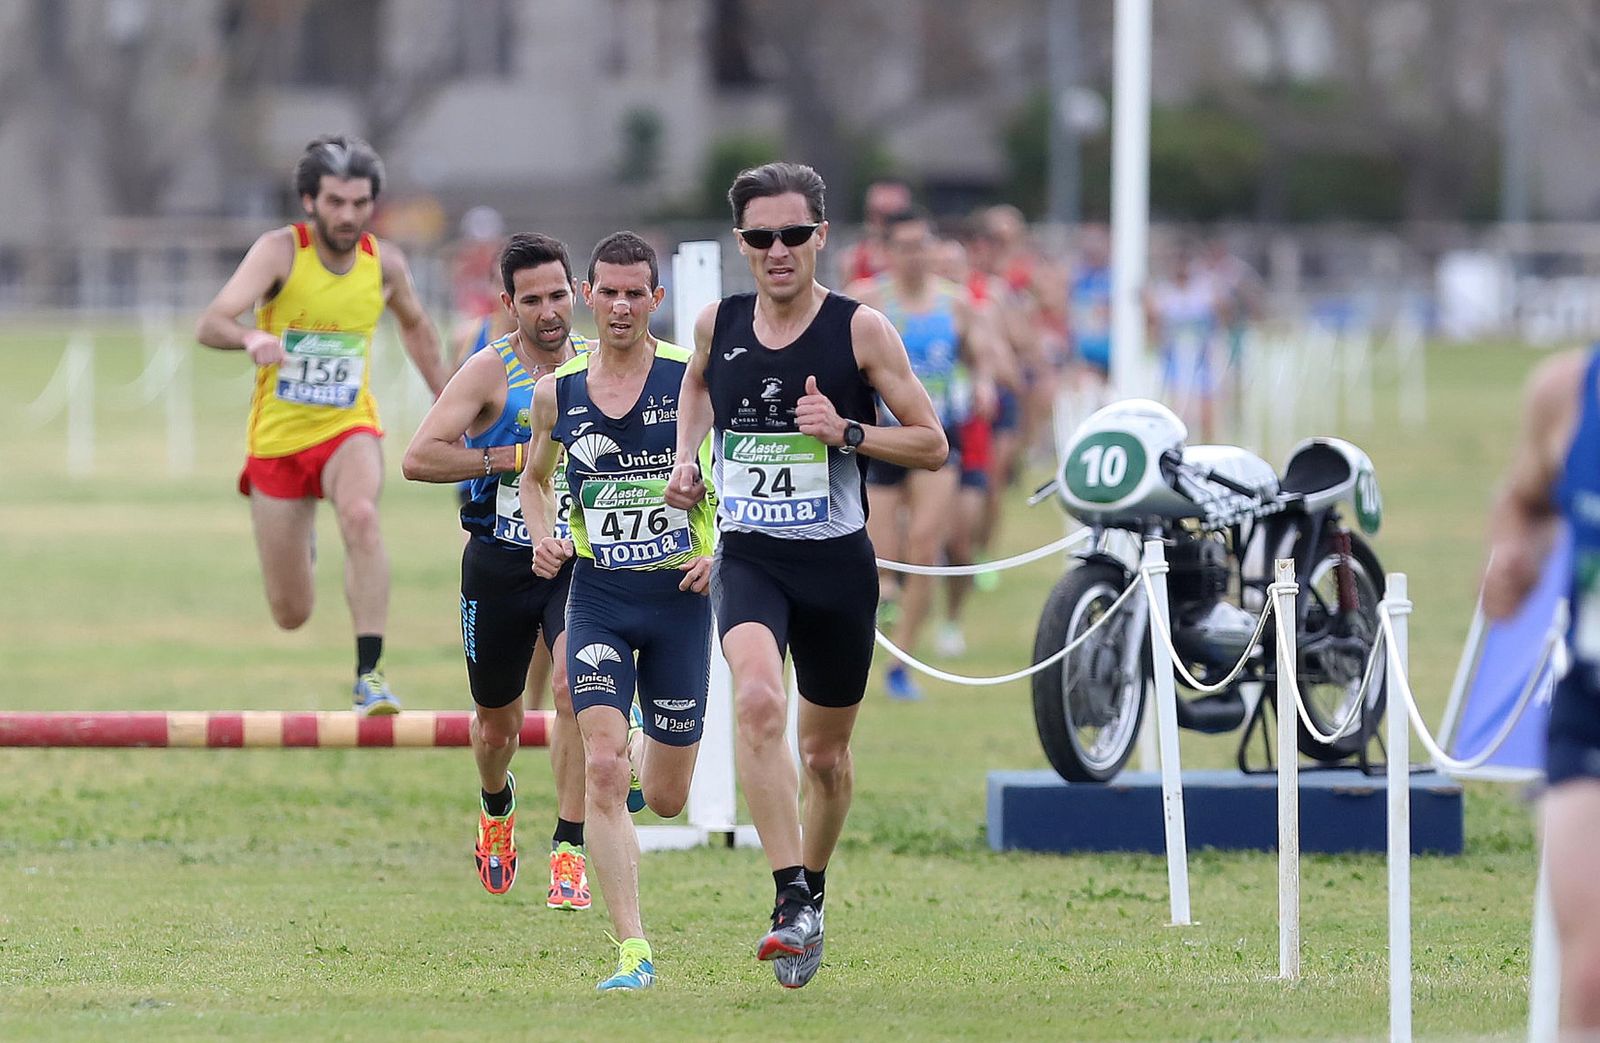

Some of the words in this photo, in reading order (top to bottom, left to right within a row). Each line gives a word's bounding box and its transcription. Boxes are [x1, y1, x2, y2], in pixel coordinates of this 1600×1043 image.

[1079, 444, 1129, 488] 10
[747, 466, 797, 499] 24
[601, 506, 669, 541] 476
[730, 500, 817, 523] Joma
[576, 671, 615, 686] Unicaja
[669, 717, 696, 731] Jaén
